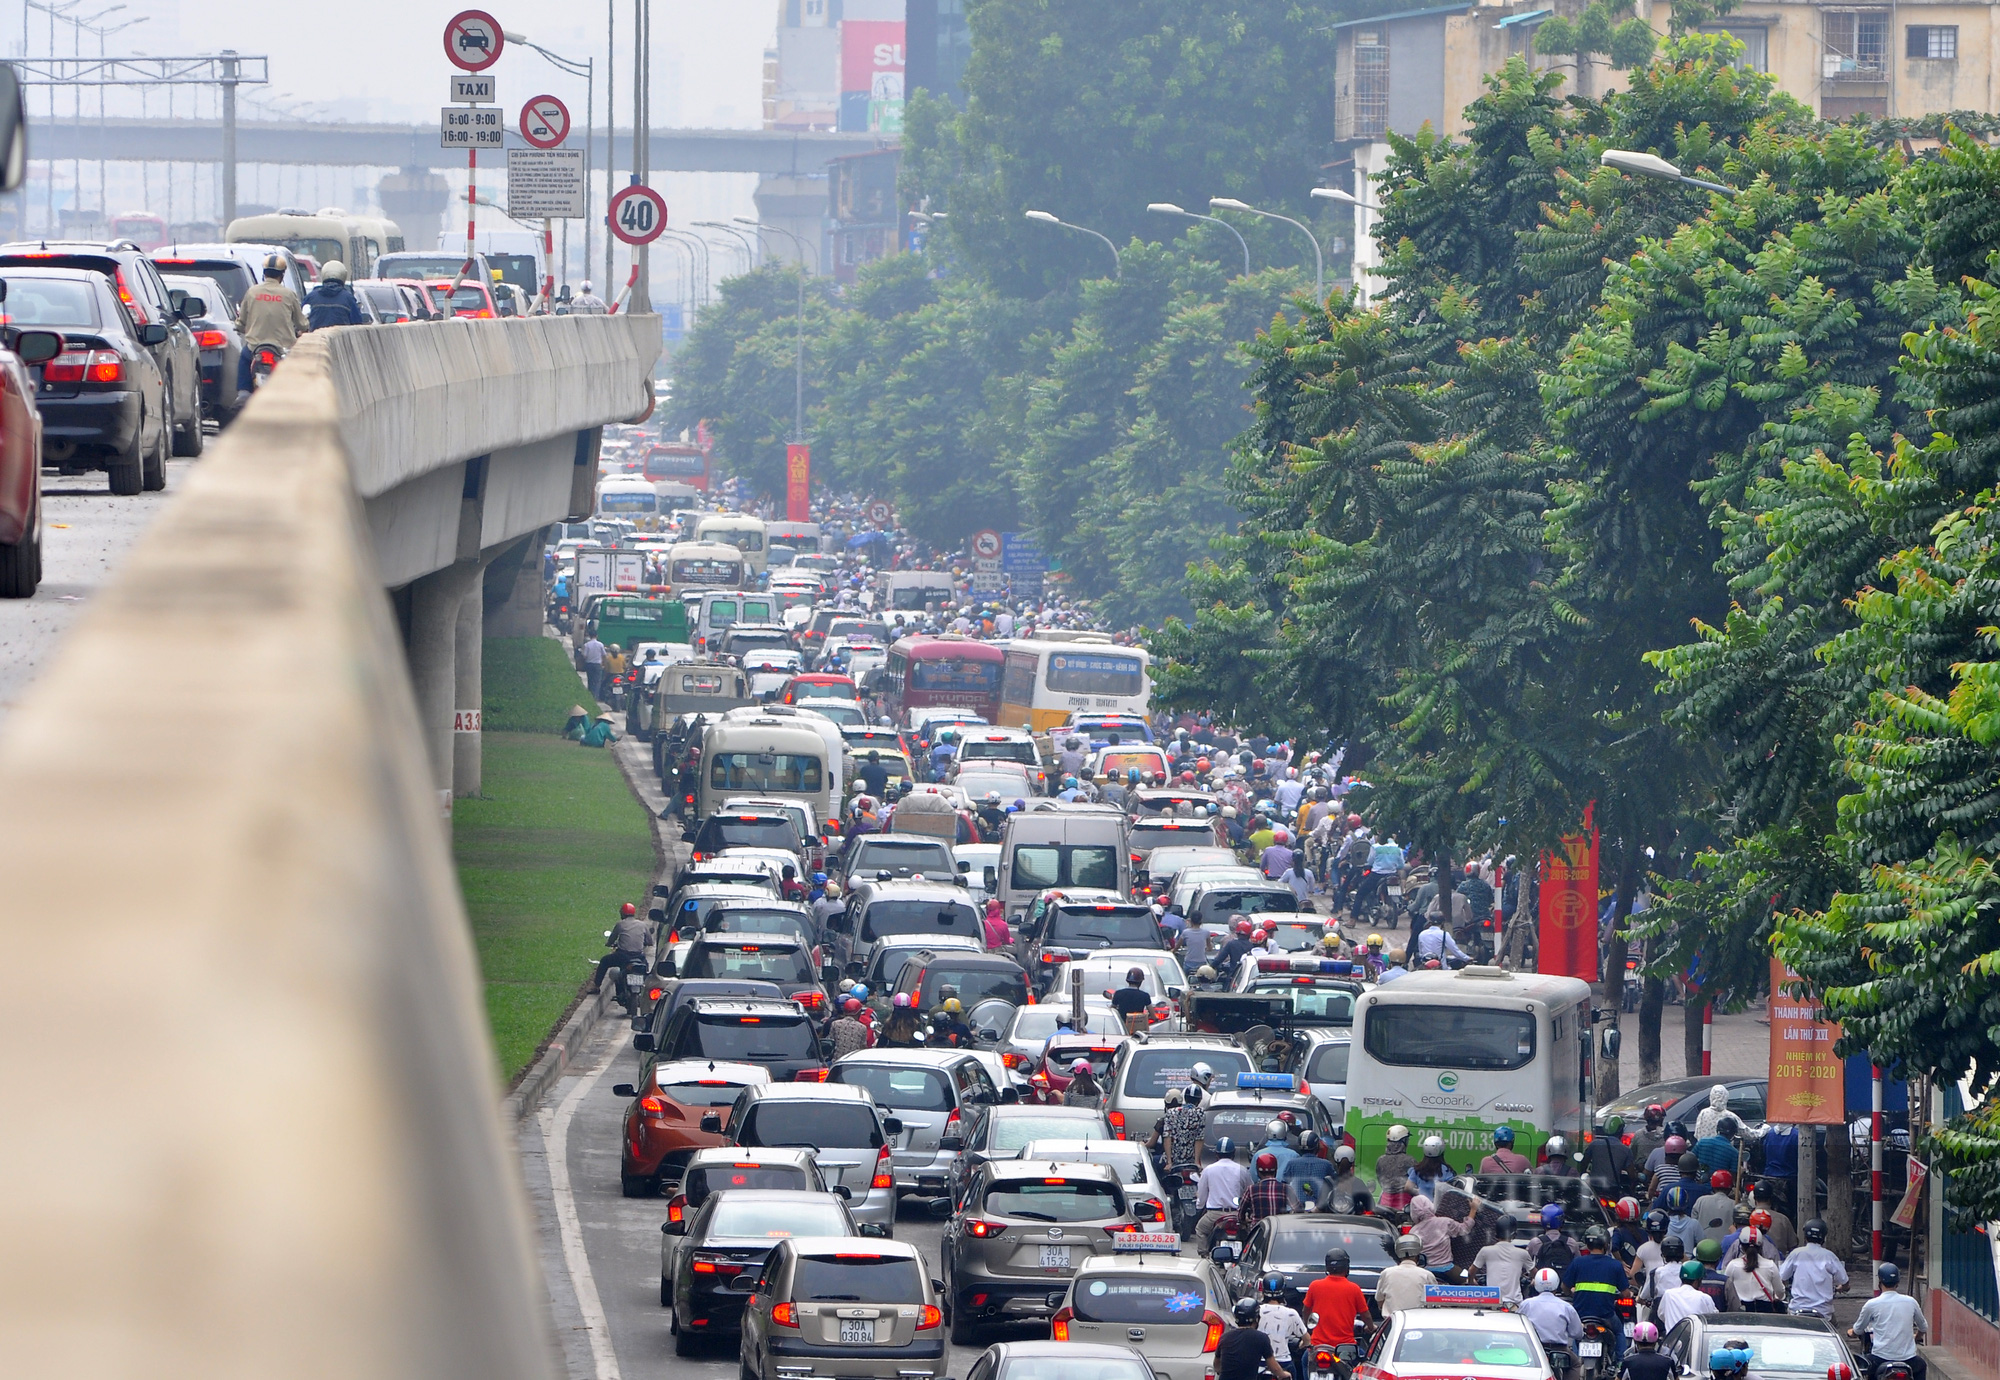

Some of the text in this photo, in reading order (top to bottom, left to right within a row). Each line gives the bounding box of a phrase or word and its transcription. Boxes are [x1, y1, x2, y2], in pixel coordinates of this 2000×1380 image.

[457, 83, 488, 95] TAXI
[449, 113, 469, 125] 6:00
[475, 114, 496, 125] 9:00
[443, 130, 468, 142] 16:00
[476, 131, 501, 142] 19:00
[621, 200, 652, 231] 40
[1551, 869, 1590, 881] 2015-2020
[1814, 1028, 1829, 1041] XVI
[1363, 1097, 1402, 1106] ISUZU
[1495, 1103, 1534, 1113] SAMCO
[1046, 1246, 1062, 1256] 30A
[848, 1321, 866, 1331] 30A
